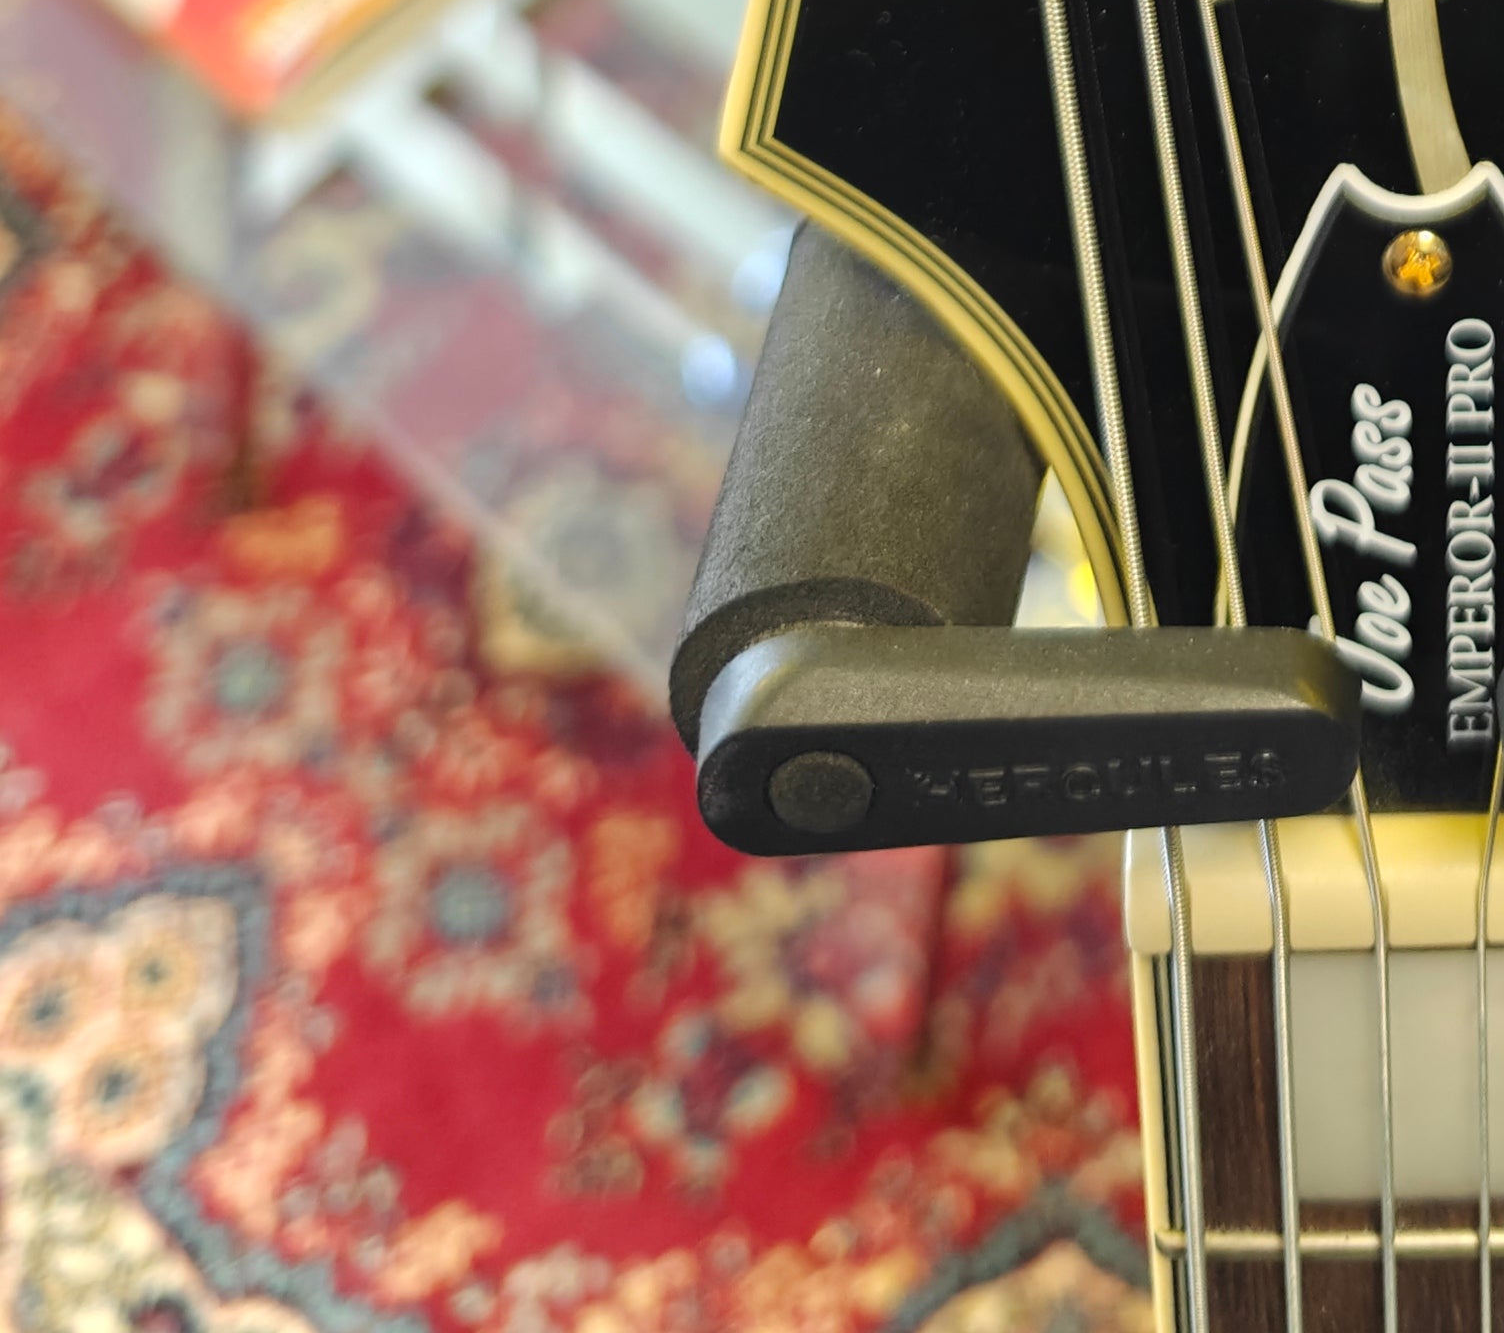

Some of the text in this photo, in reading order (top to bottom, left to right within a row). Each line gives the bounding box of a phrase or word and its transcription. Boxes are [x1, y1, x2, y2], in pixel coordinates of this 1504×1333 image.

[1307, 383, 1417, 713] Joe Pass
[1445, 318, 1496, 747] EMPEROR-II PRO
